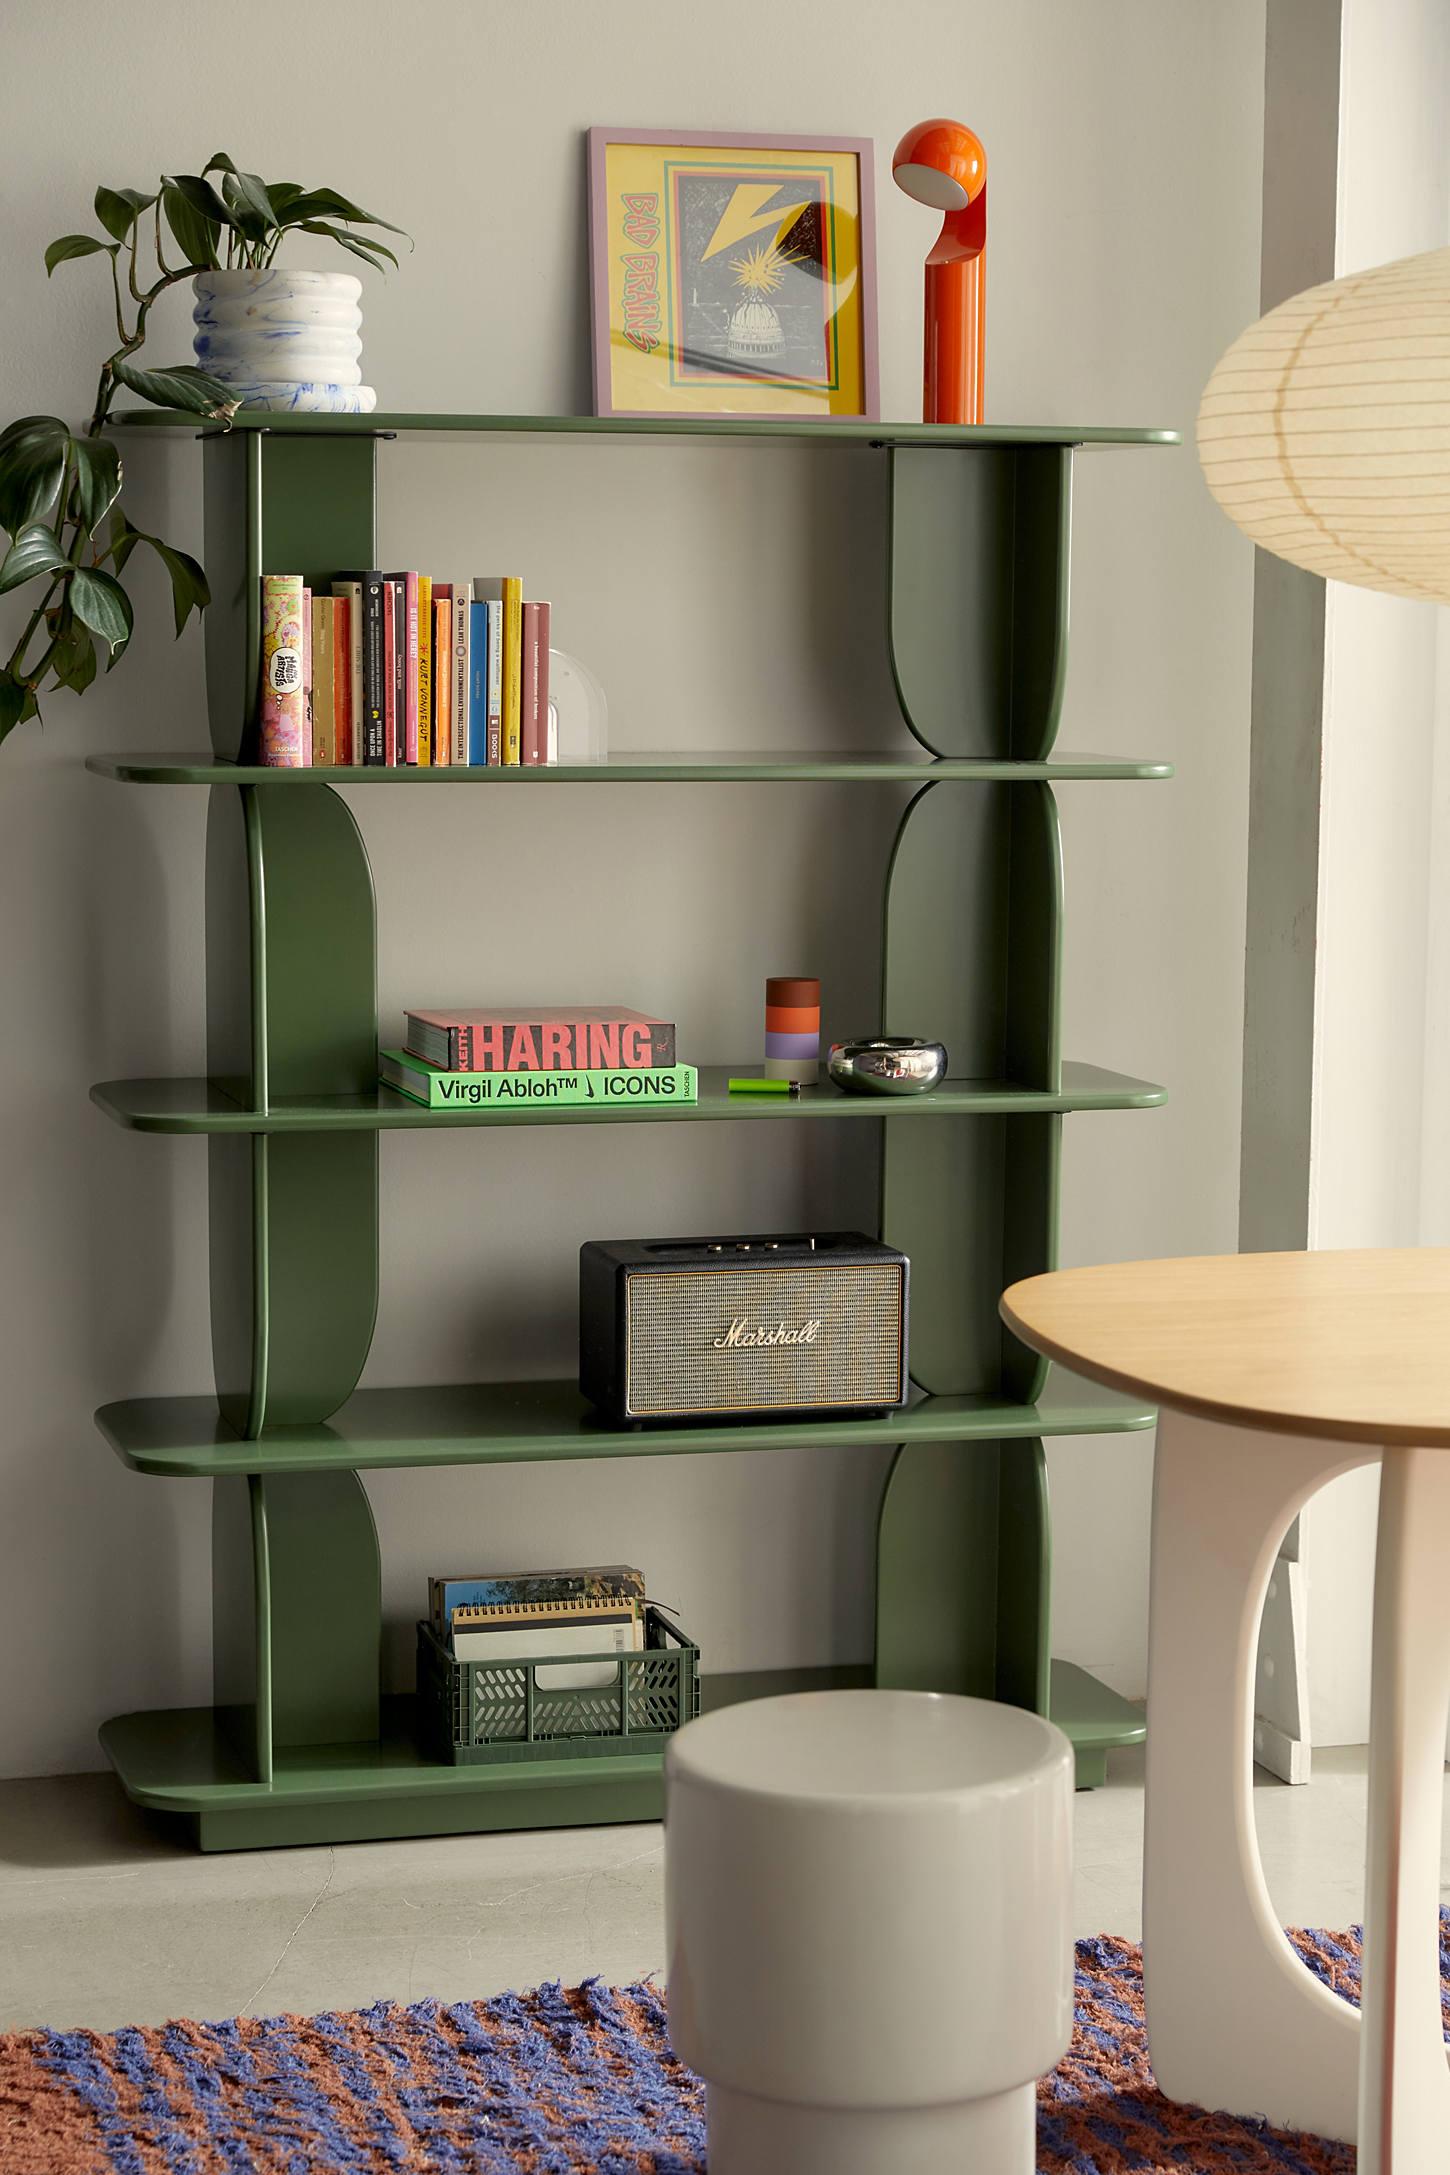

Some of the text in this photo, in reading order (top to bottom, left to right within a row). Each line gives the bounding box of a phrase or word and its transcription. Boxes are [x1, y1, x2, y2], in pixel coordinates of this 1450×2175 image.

[621, 192, 663, 354] BAD BRAINS
[275, 655, 287, 687] ARTISTS
[285, 656, 297, 684] MANGA
[420, 658, 428, 742] KURT VONNEGUT
[458, 1024, 470, 1072] KEITH
[472, 1024, 652, 1072] HARING
[438, 1080, 492, 1104] Virgil
[604, 1076, 676, 1096] ICONS
[713, 1318, 821, 1349] Marshall
